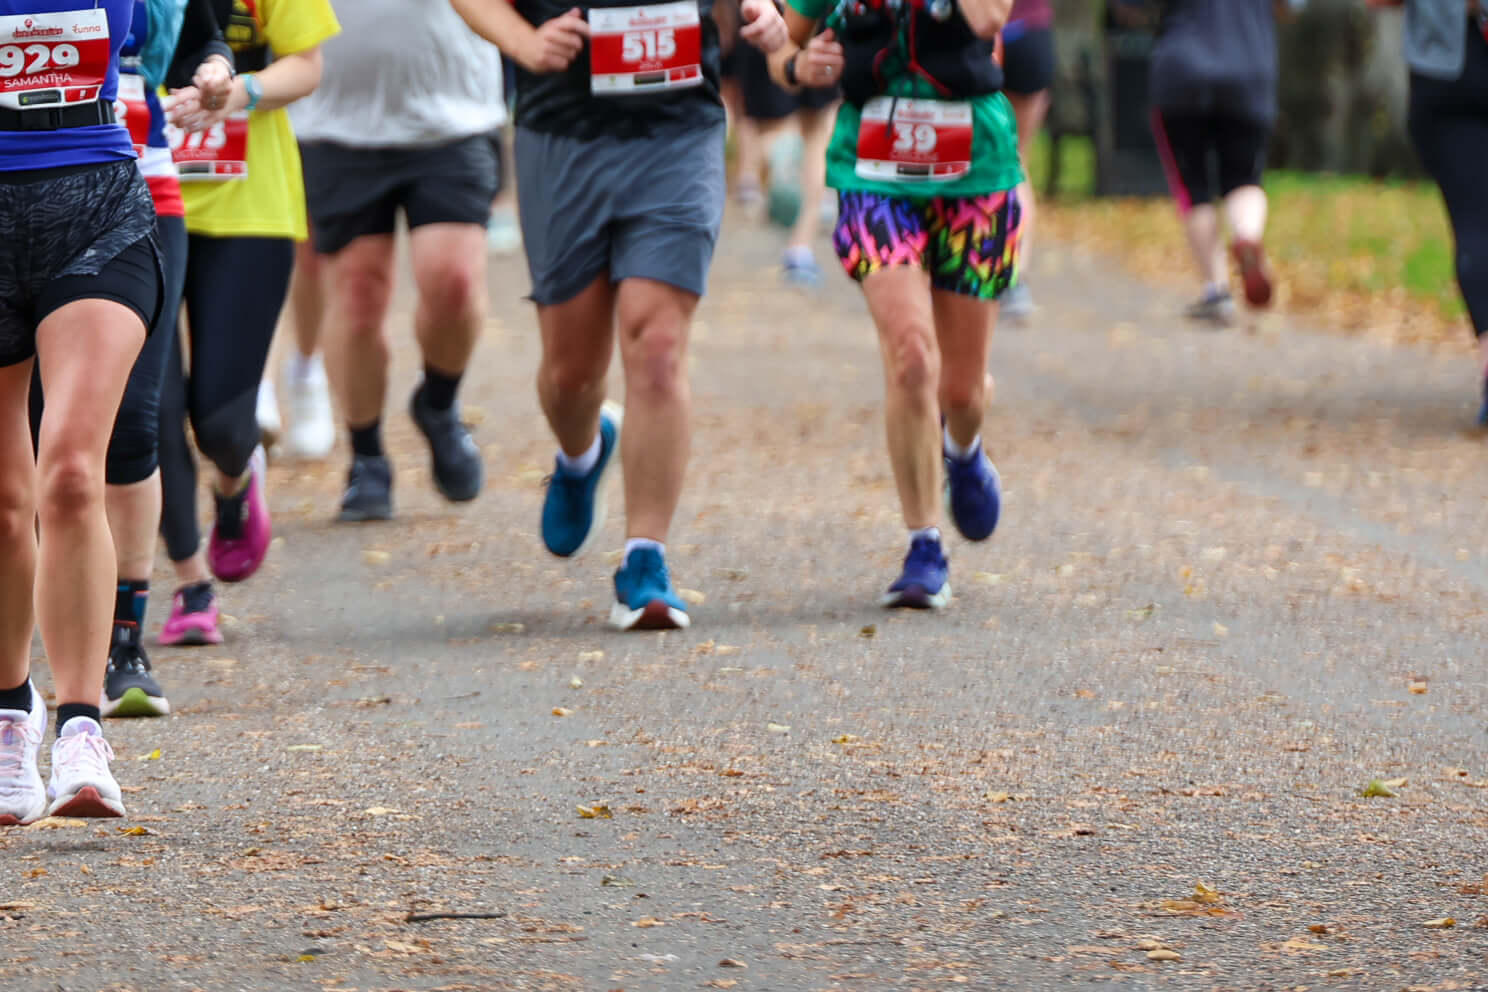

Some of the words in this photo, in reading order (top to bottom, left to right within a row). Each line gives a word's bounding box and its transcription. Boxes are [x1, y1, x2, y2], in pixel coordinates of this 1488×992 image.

[622, 29, 677, 63] 515
[4, 73, 73, 89] SAMANTHA
[893, 122, 937, 152] 39
